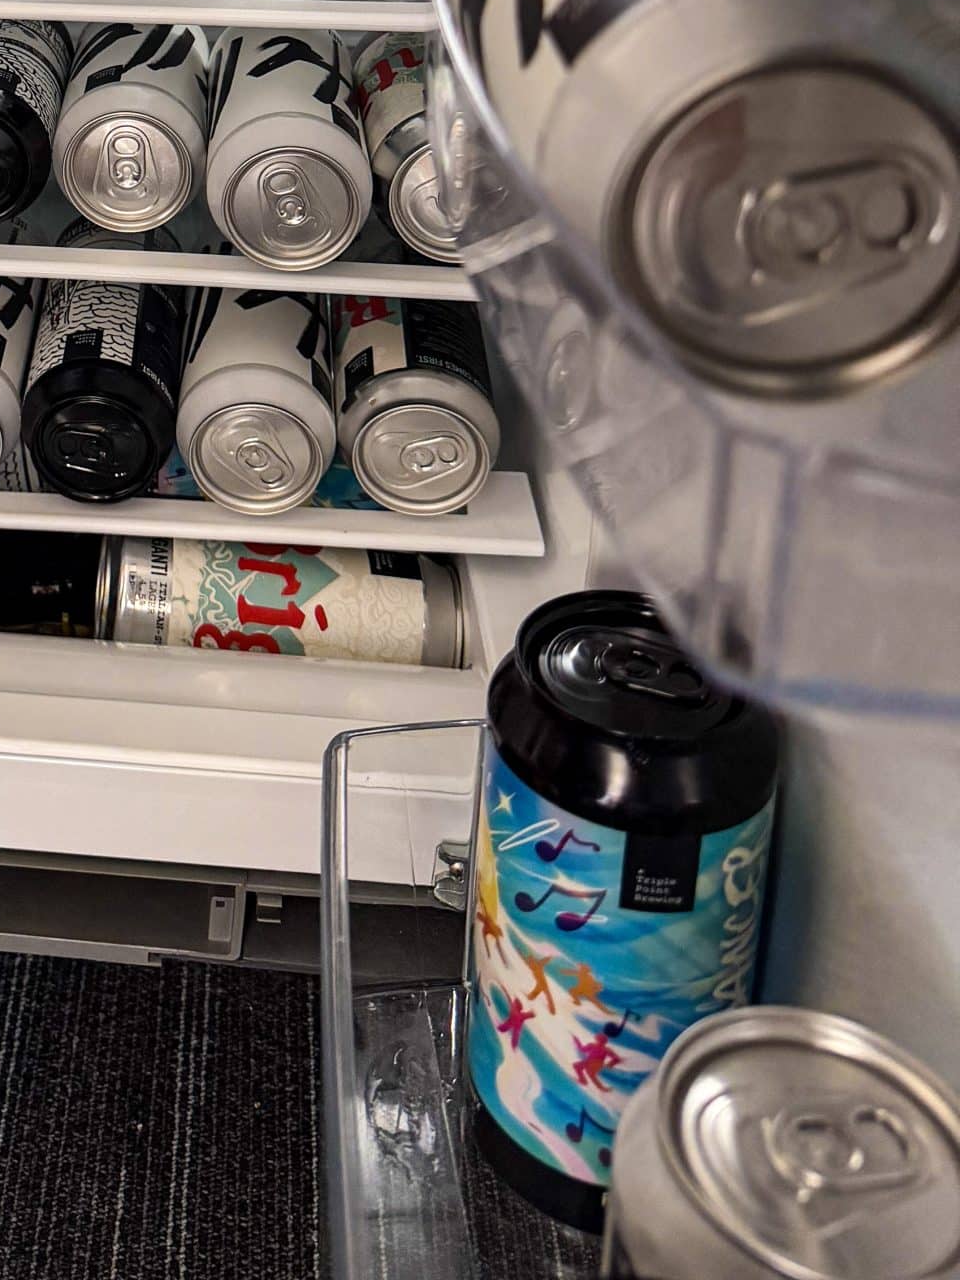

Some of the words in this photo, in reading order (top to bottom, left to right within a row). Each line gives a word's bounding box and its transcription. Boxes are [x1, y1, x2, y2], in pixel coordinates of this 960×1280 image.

[150, 537, 169, 576] GANTI
[635, 874, 677, 887] Triple
[634, 884, 670, 895] Point
[633, 893, 683, 905] Brewing
